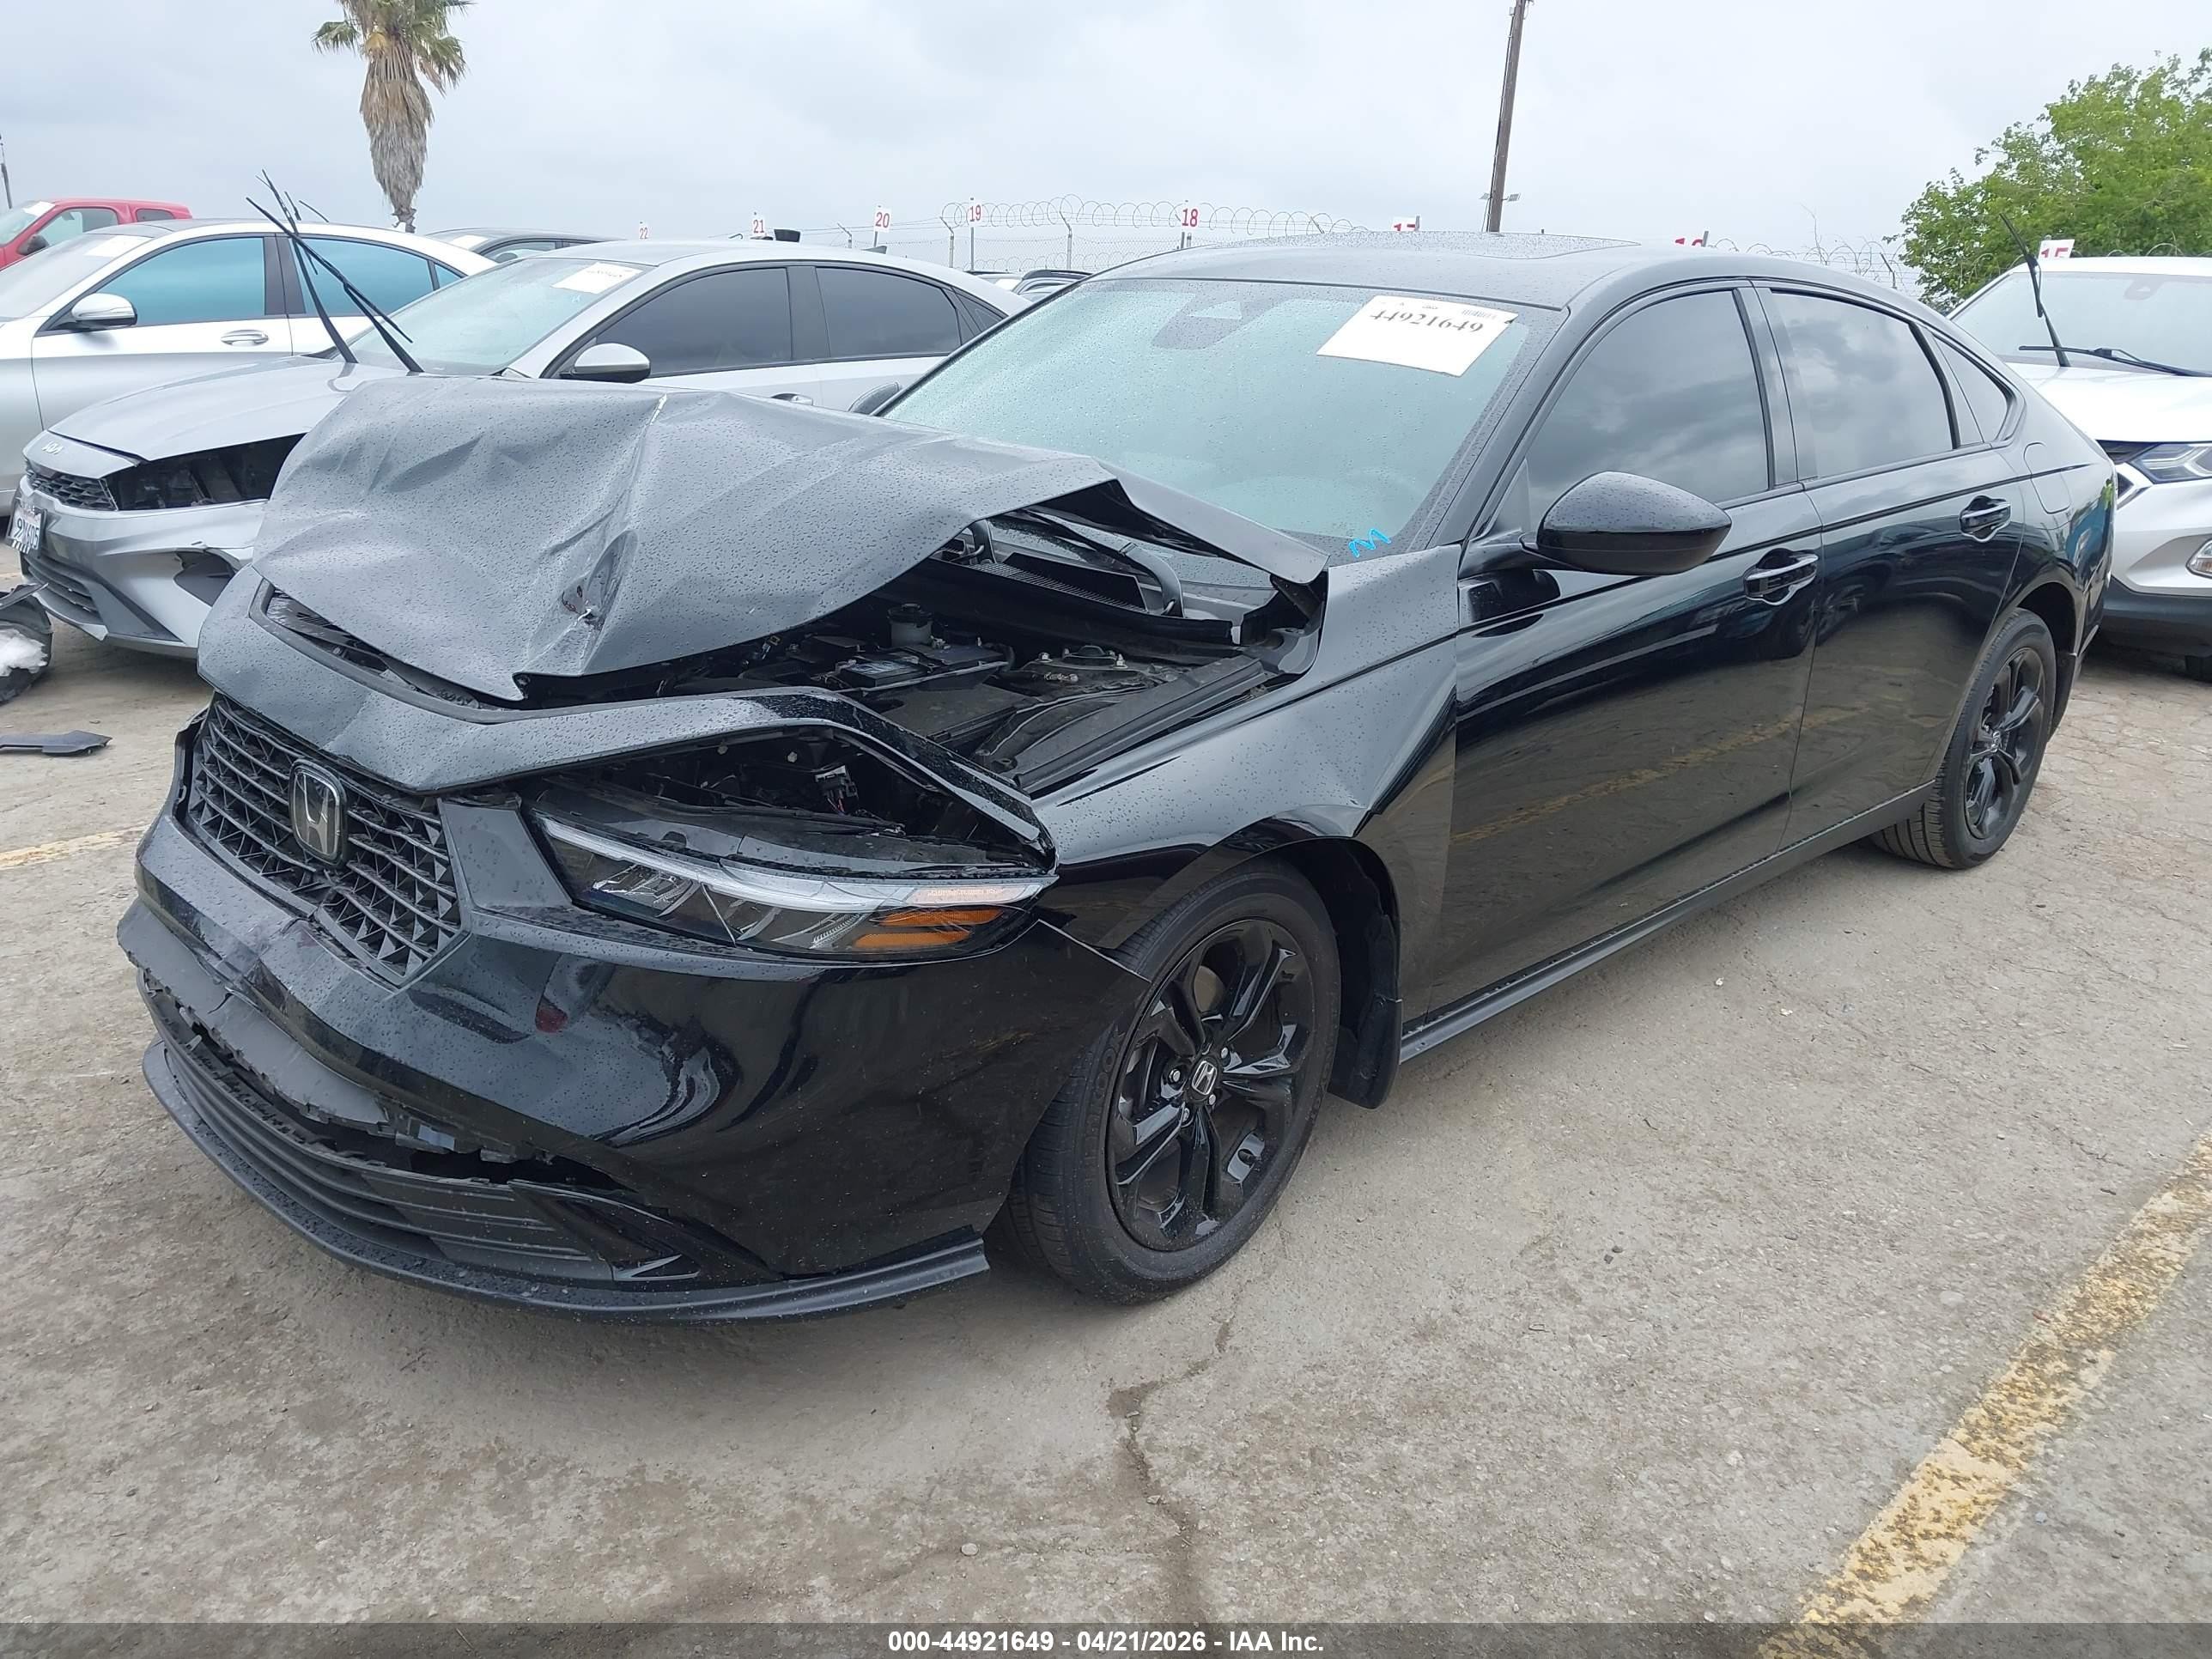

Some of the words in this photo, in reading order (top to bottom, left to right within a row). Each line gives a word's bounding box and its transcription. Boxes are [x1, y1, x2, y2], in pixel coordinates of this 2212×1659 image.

[875, 211, 890, 228] 20
[969, 204, 981, 222] 19
[1182, 208, 1199, 228] 18
[639, 227, 648, 240] 22
[753, 219, 764, 234] 21
[1370, 309, 1484, 332] 44921649
